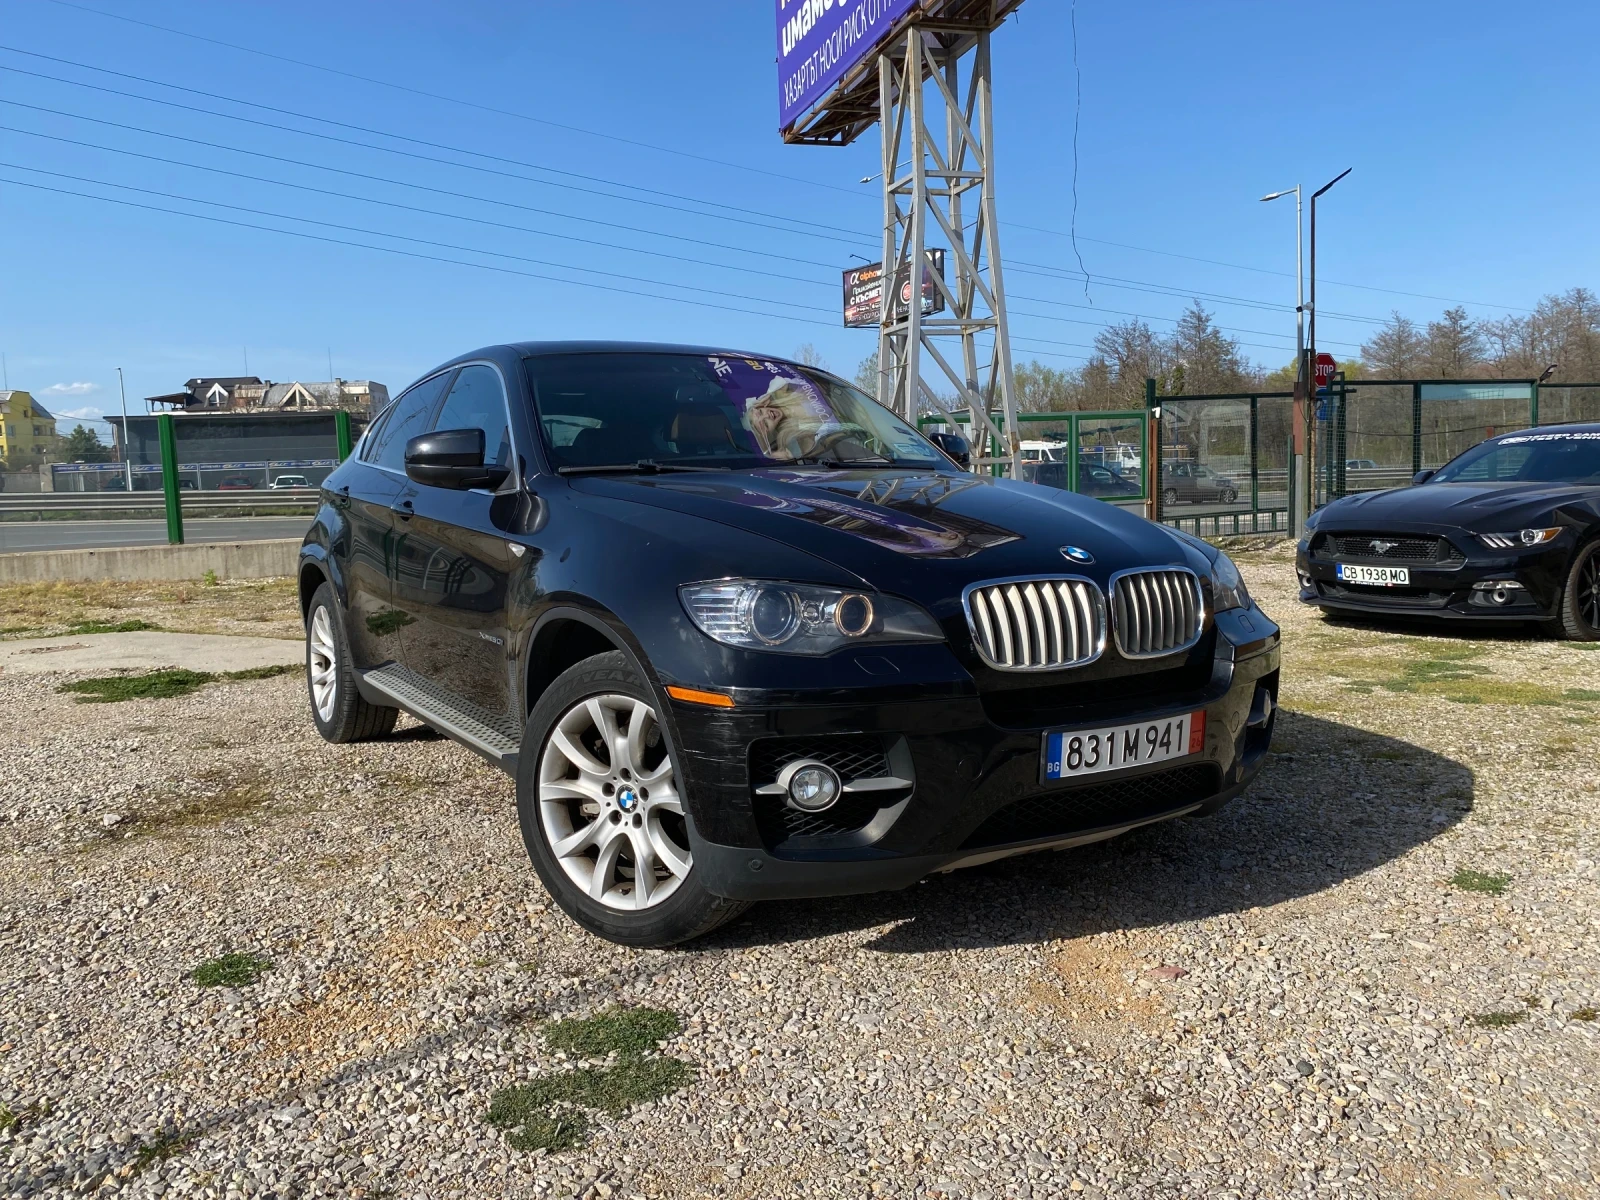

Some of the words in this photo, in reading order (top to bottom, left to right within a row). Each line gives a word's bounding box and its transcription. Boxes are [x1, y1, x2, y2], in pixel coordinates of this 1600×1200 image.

[784, 50, 819, 110] ХАЗАРТЪТ
[819, 25, 843, 77] НОСИ
[843, 1, 868, 53] РИСК
[1315, 364, 1334, 376] STOP
[1343, 566, 1357, 579] CB
[1360, 567, 1388, 581] 1938
[1389, 569, 1407, 582] MO
[1065, 731, 1116, 771] 831
[1145, 719, 1184, 759] 941
[1047, 762, 1060, 773] BG
